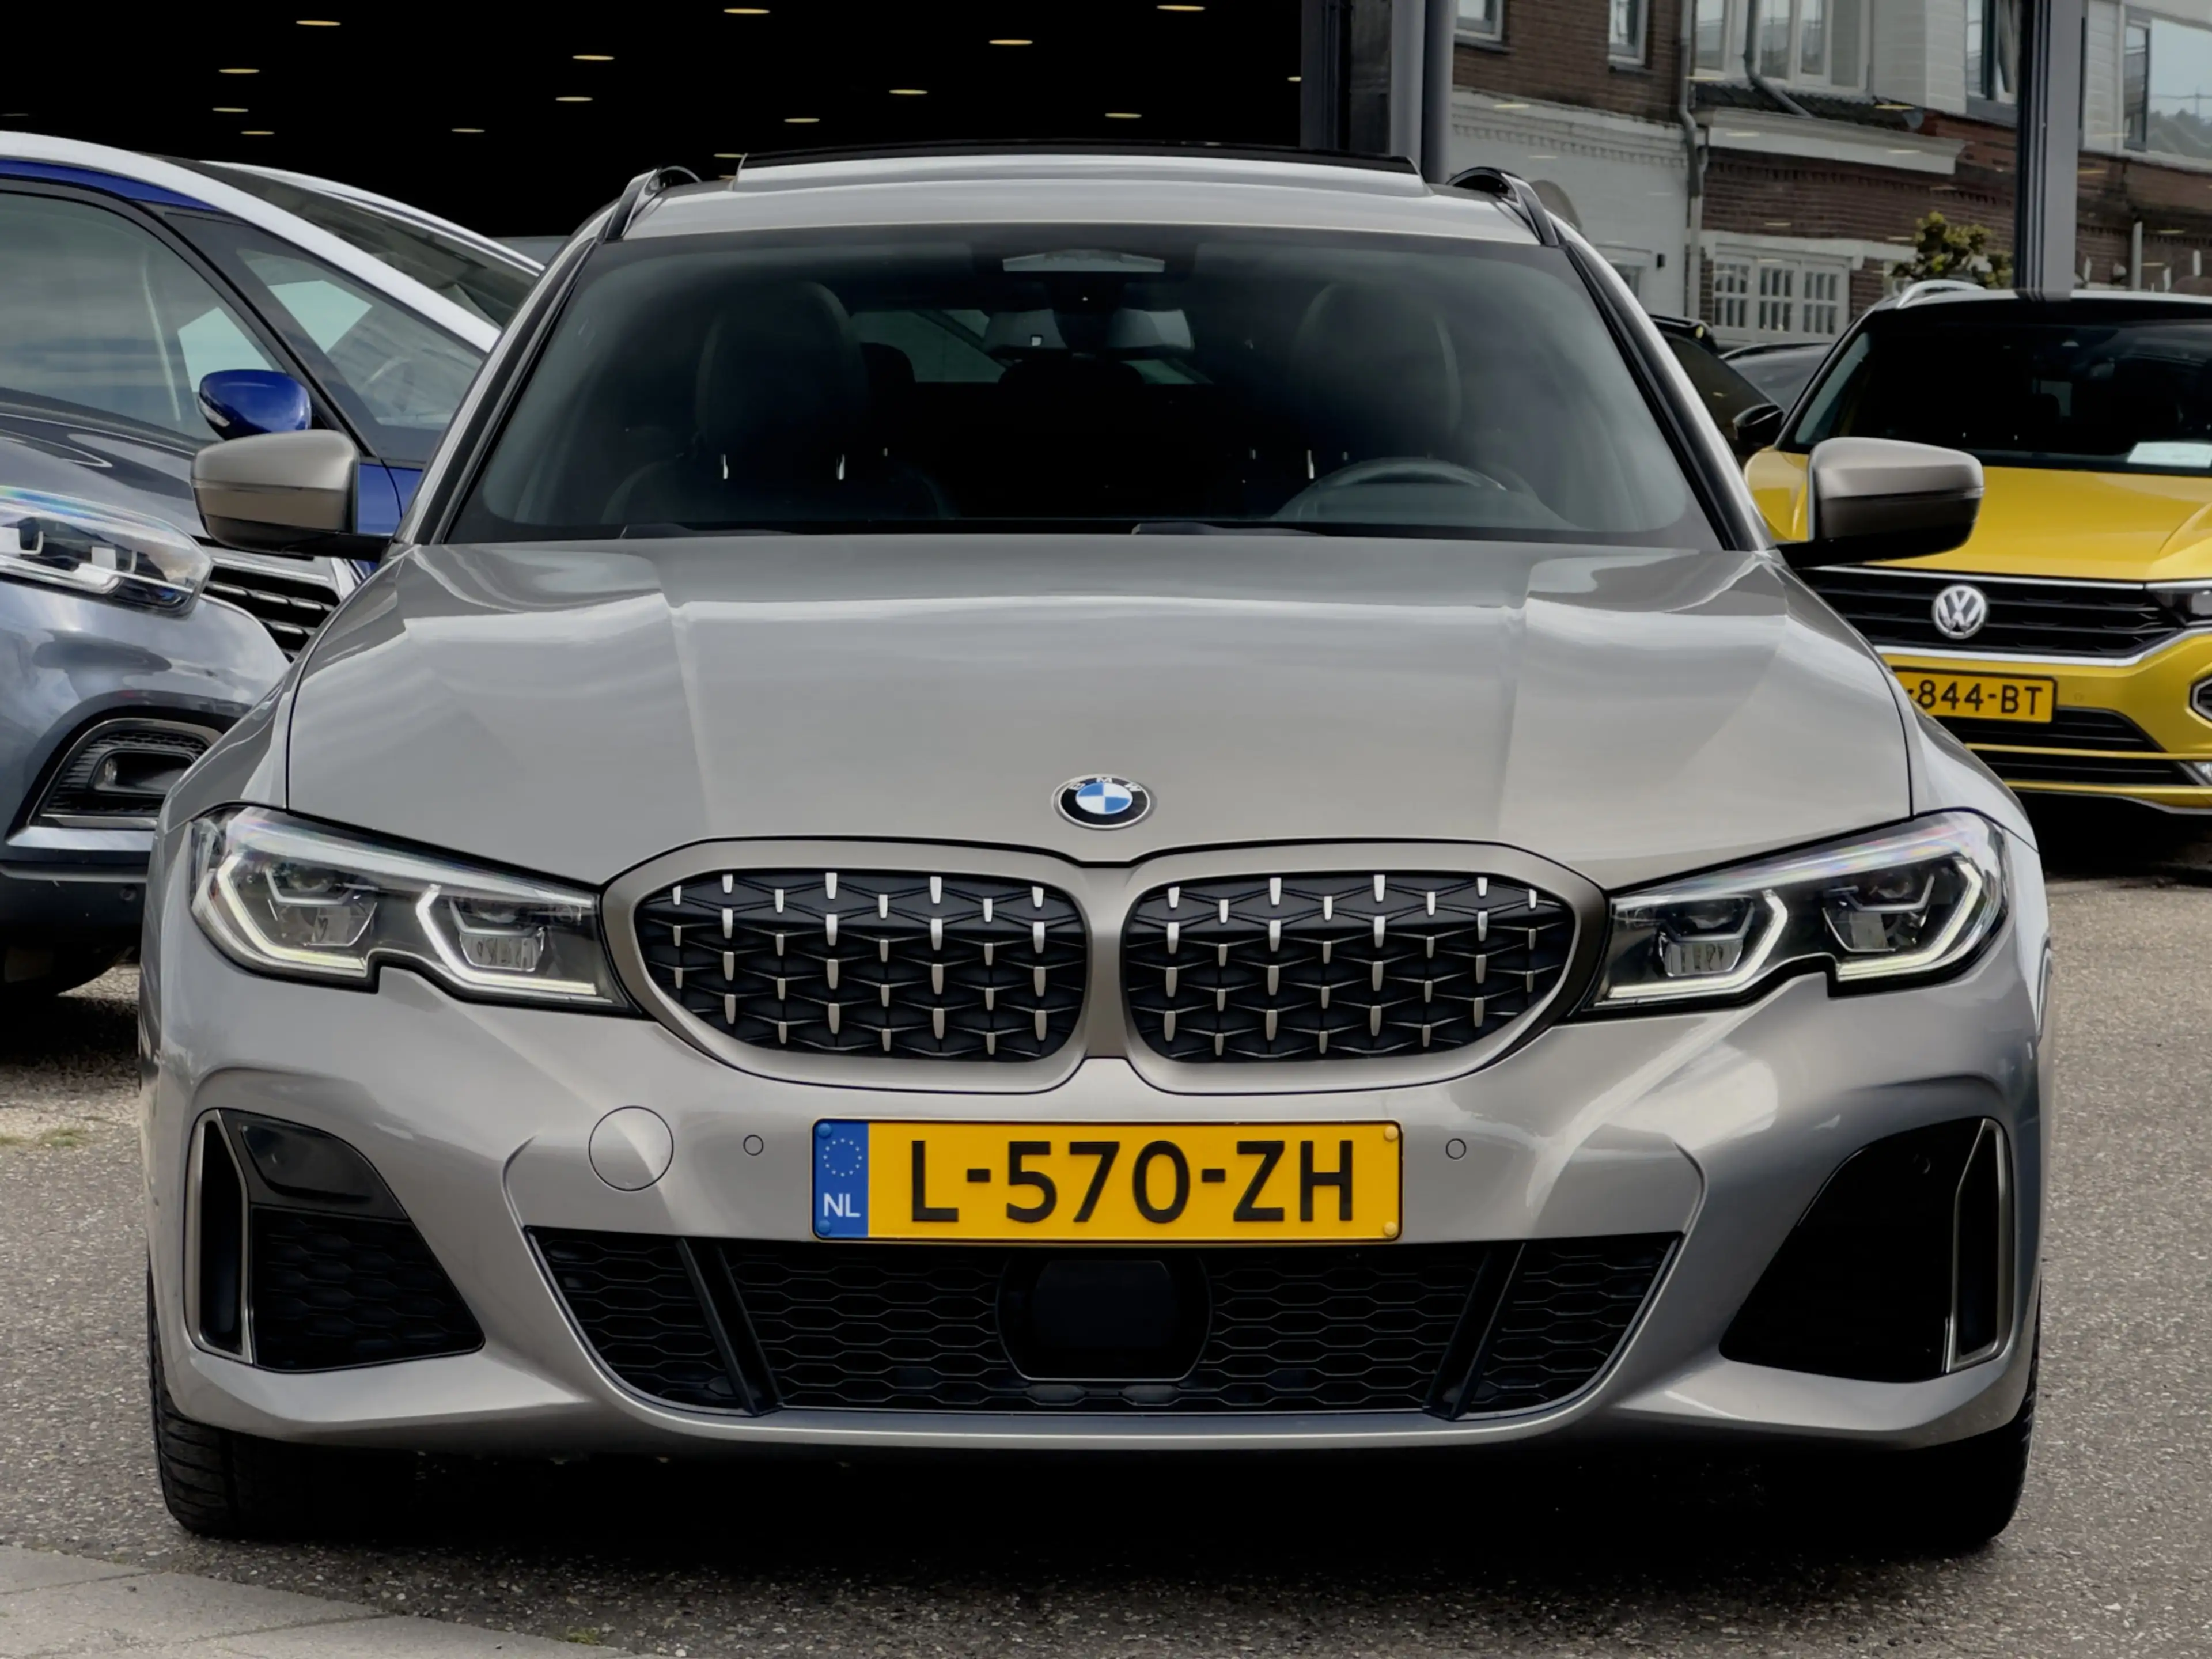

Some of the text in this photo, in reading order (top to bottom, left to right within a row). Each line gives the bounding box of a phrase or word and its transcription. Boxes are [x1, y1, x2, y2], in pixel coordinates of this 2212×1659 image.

[1935, 588, 1985, 634] VW
[1068, 777, 1142, 792] BMW
[911, 1139, 1353, 1223] L-570-ZH
[823, 1193, 860, 1218] NL
